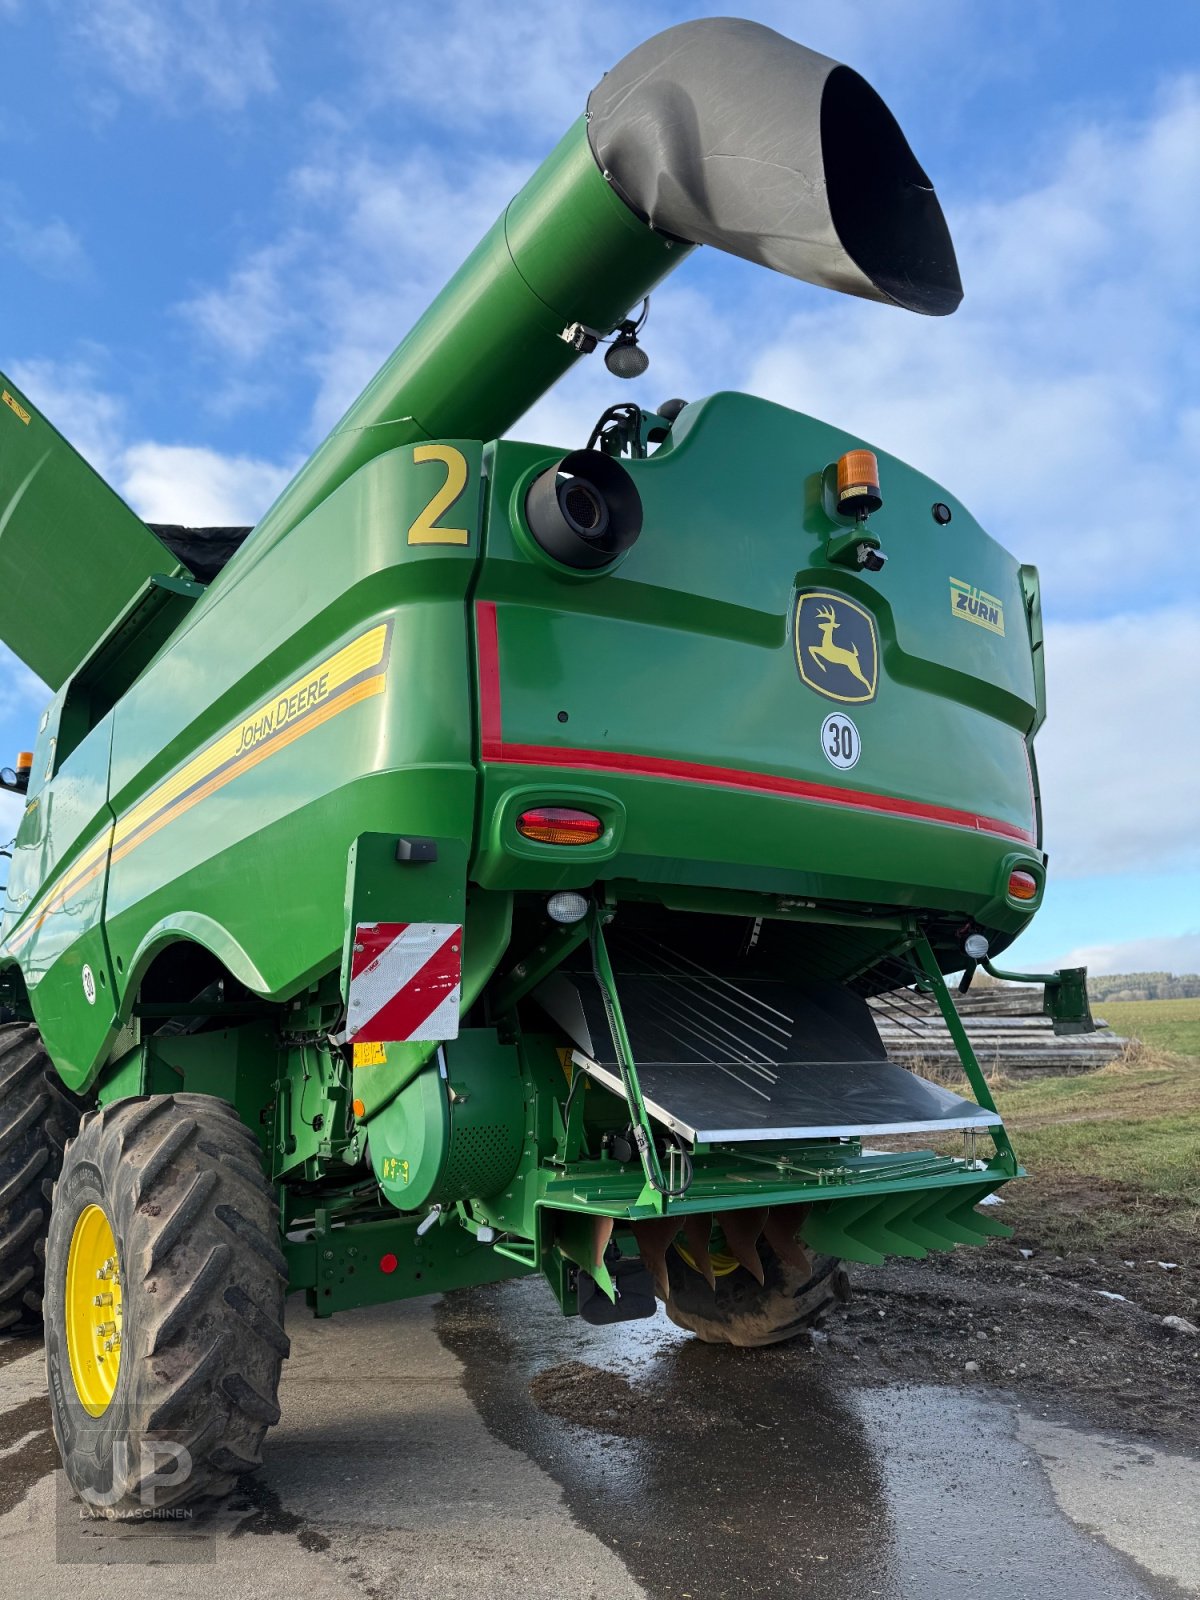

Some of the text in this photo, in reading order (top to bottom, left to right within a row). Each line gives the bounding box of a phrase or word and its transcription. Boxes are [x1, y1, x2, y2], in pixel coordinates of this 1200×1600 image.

[407, 444, 469, 546] 2
[235, 671, 330, 754] JOHN DEERE
[829, 722, 853, 760] 30
